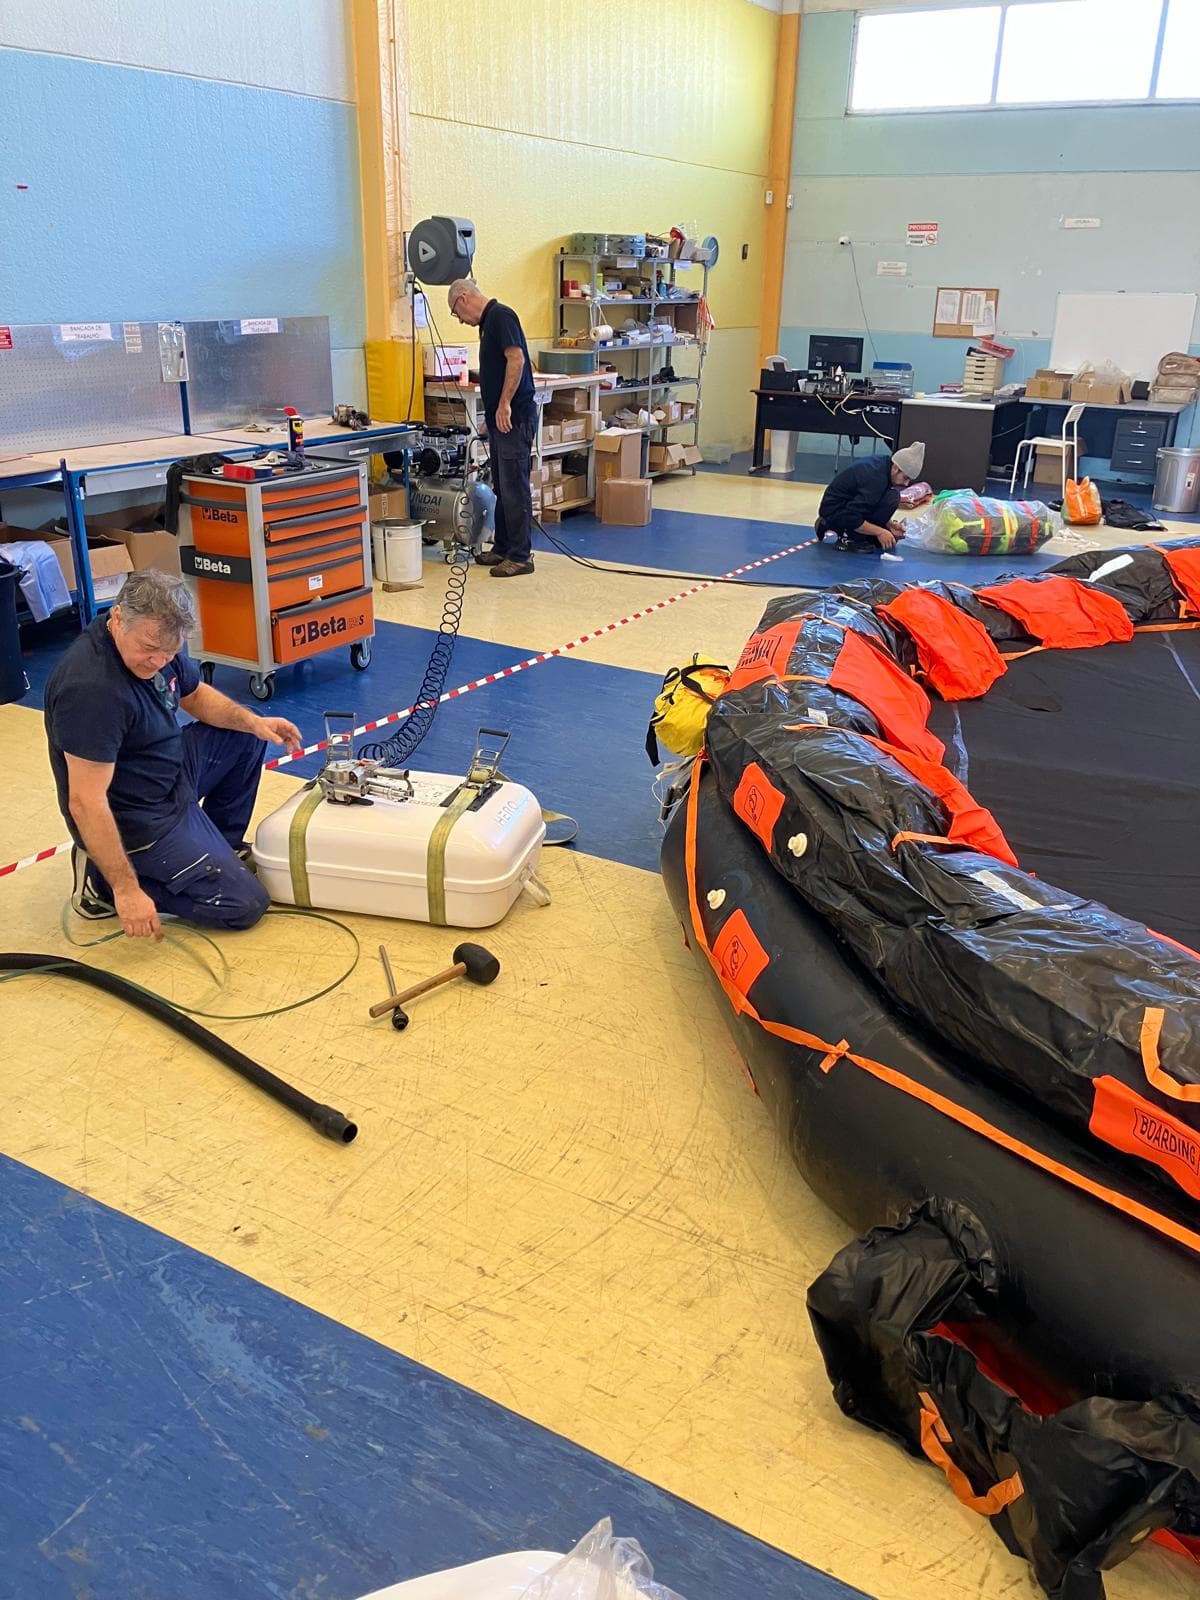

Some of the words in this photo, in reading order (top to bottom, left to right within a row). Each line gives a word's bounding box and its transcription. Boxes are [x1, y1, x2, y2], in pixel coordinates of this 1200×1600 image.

[212, 509, 238, 523] Beta
[203, 558, 231, 574] Beta
[307, 616, 347, 642] Beta
[1140, 1115, 1196, 1165] BOARDING
